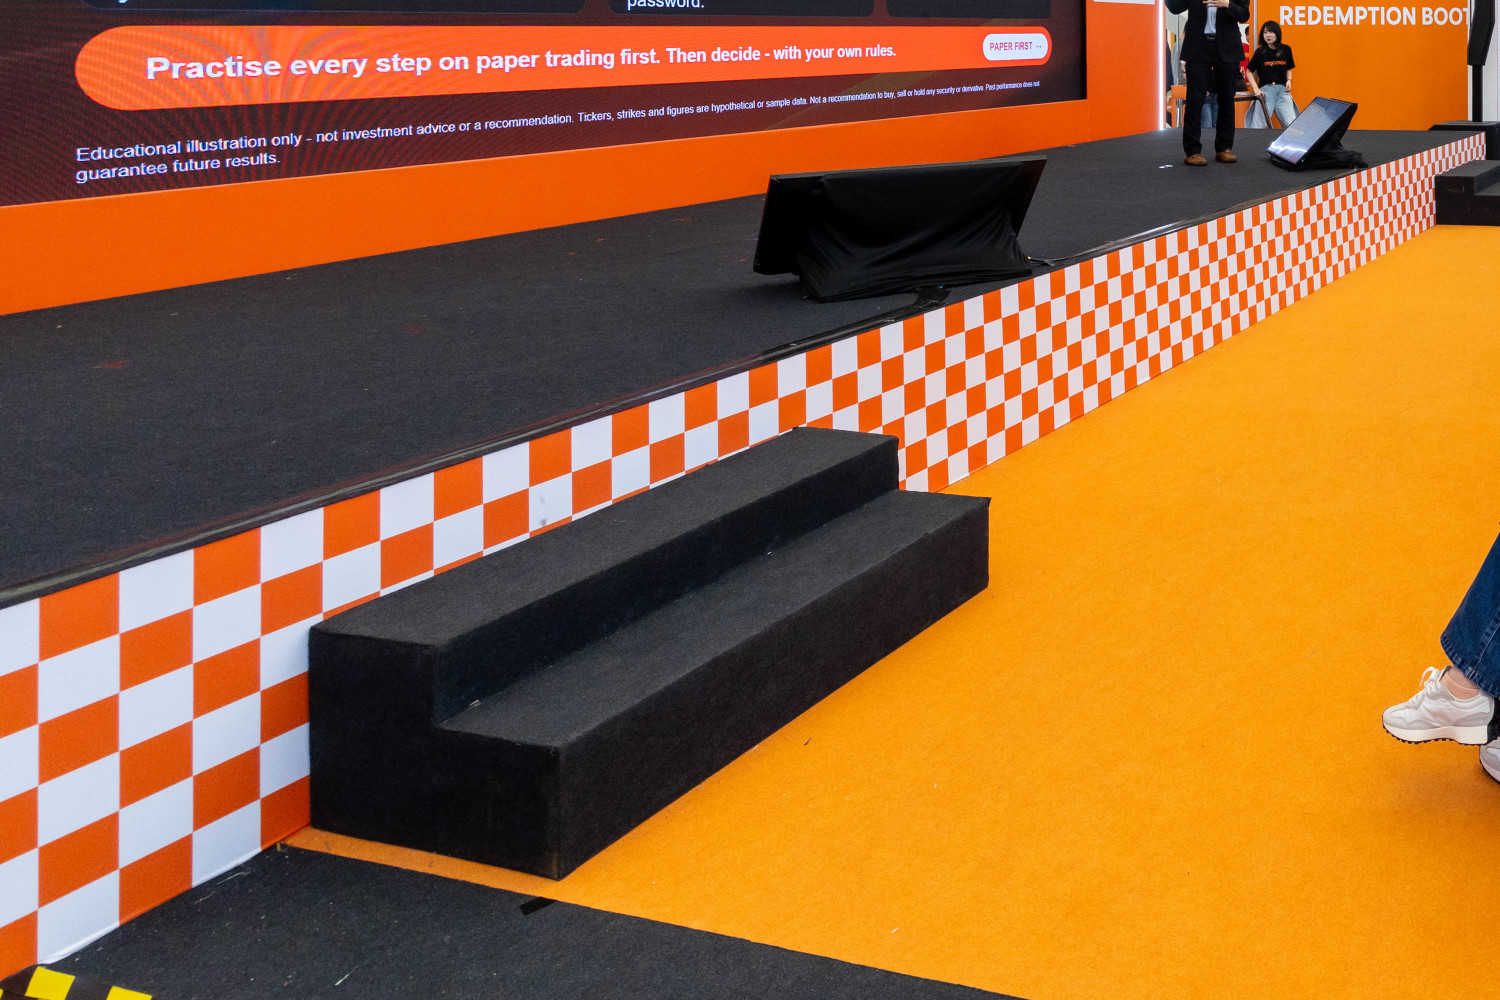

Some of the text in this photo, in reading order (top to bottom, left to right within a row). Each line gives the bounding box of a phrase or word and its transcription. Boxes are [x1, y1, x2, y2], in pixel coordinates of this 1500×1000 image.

[1279, 6, 1469, 26] REDEMPTION BOOT
[990, 41, 1033, 51] PAPER FIRST
[145, 56, 281, 80] Practise
[289, 58, 368, 78] every
[376, 53, 432, 76] step
[438, 56, 469, 70] on
[476, 55, 540, 74] paper
[544, 49, 615, 69] trading
[620, 48, 660, 65] first.
[665, 47, 707, 63] Then
[711, 46, 761, 62] decide
[773, 45, 802, 60] with
[805, 48, 834, 62] your
[837, 47, 862, 58] own
[865, 44, 896, 57] rules.
[75, 153, 280, 184] guarantee future results.
